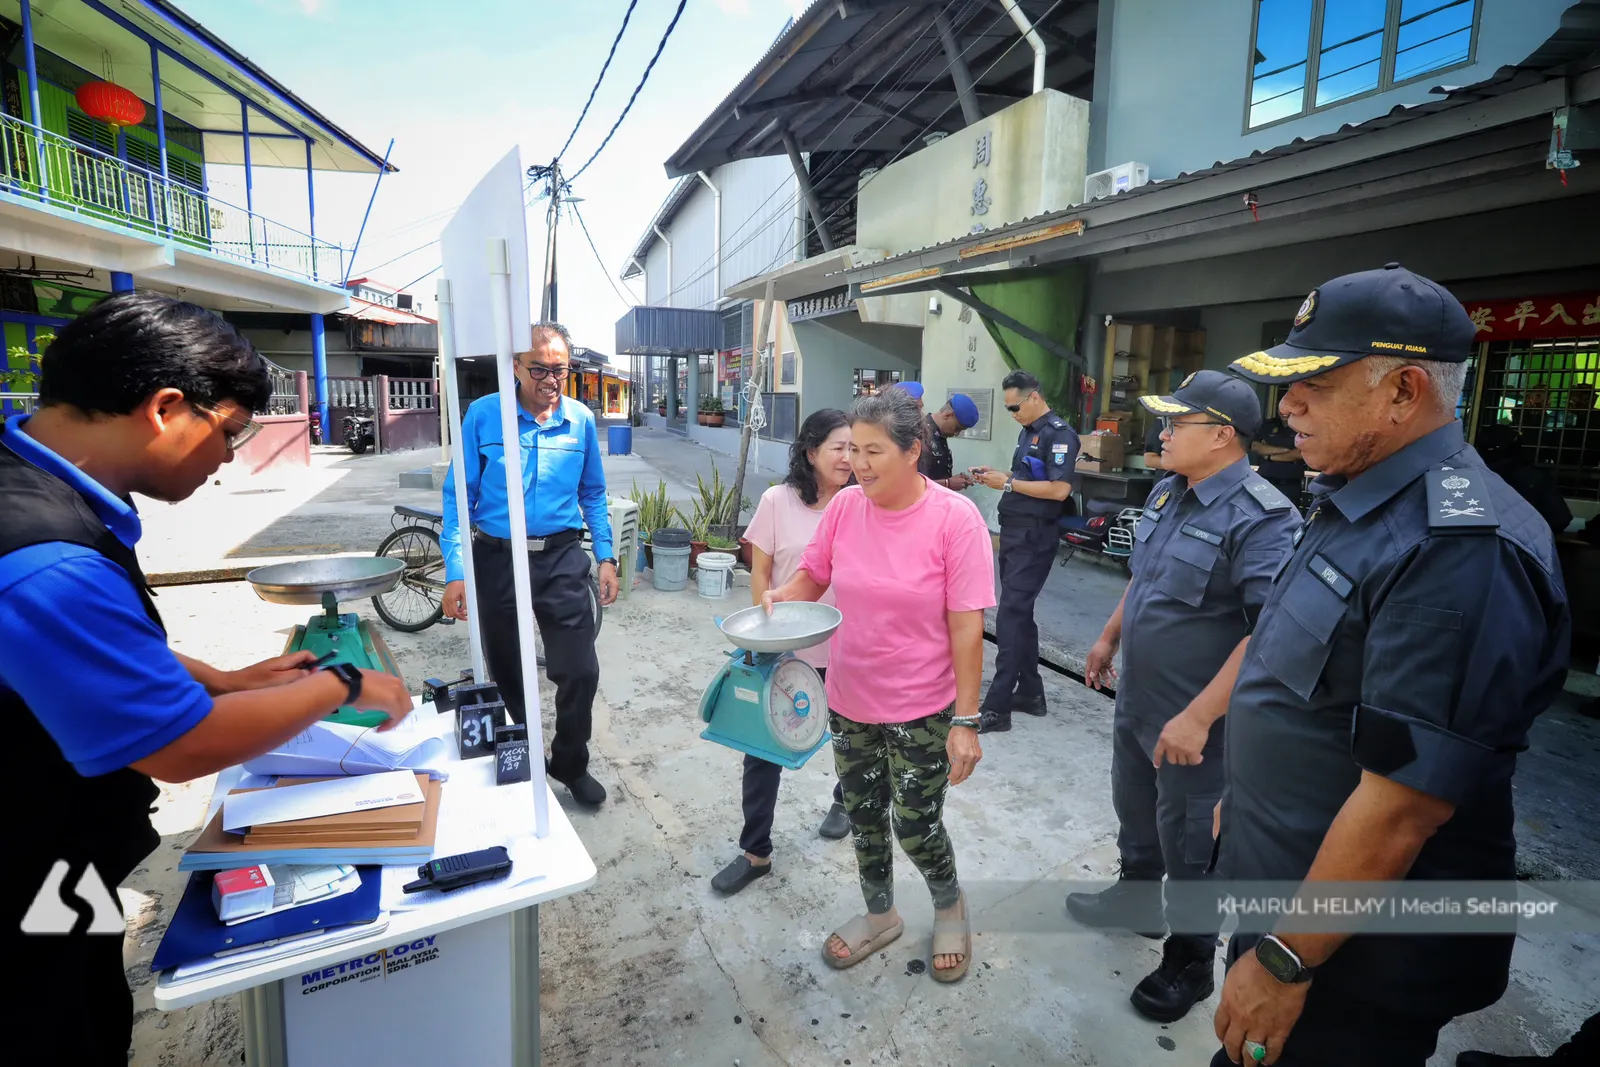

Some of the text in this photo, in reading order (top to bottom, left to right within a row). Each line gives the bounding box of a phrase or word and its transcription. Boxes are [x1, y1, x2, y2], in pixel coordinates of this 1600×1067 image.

[1371, 341, 1427, 353] PENGUAT KUASA
[462, 714, 493, 747] 31
[301, 935, 437, 986] METROLOGY
[301, 947, 439, 995] CORPORATION MALAYSIA
[387, 954, 440, 975] SDN. BHD.
